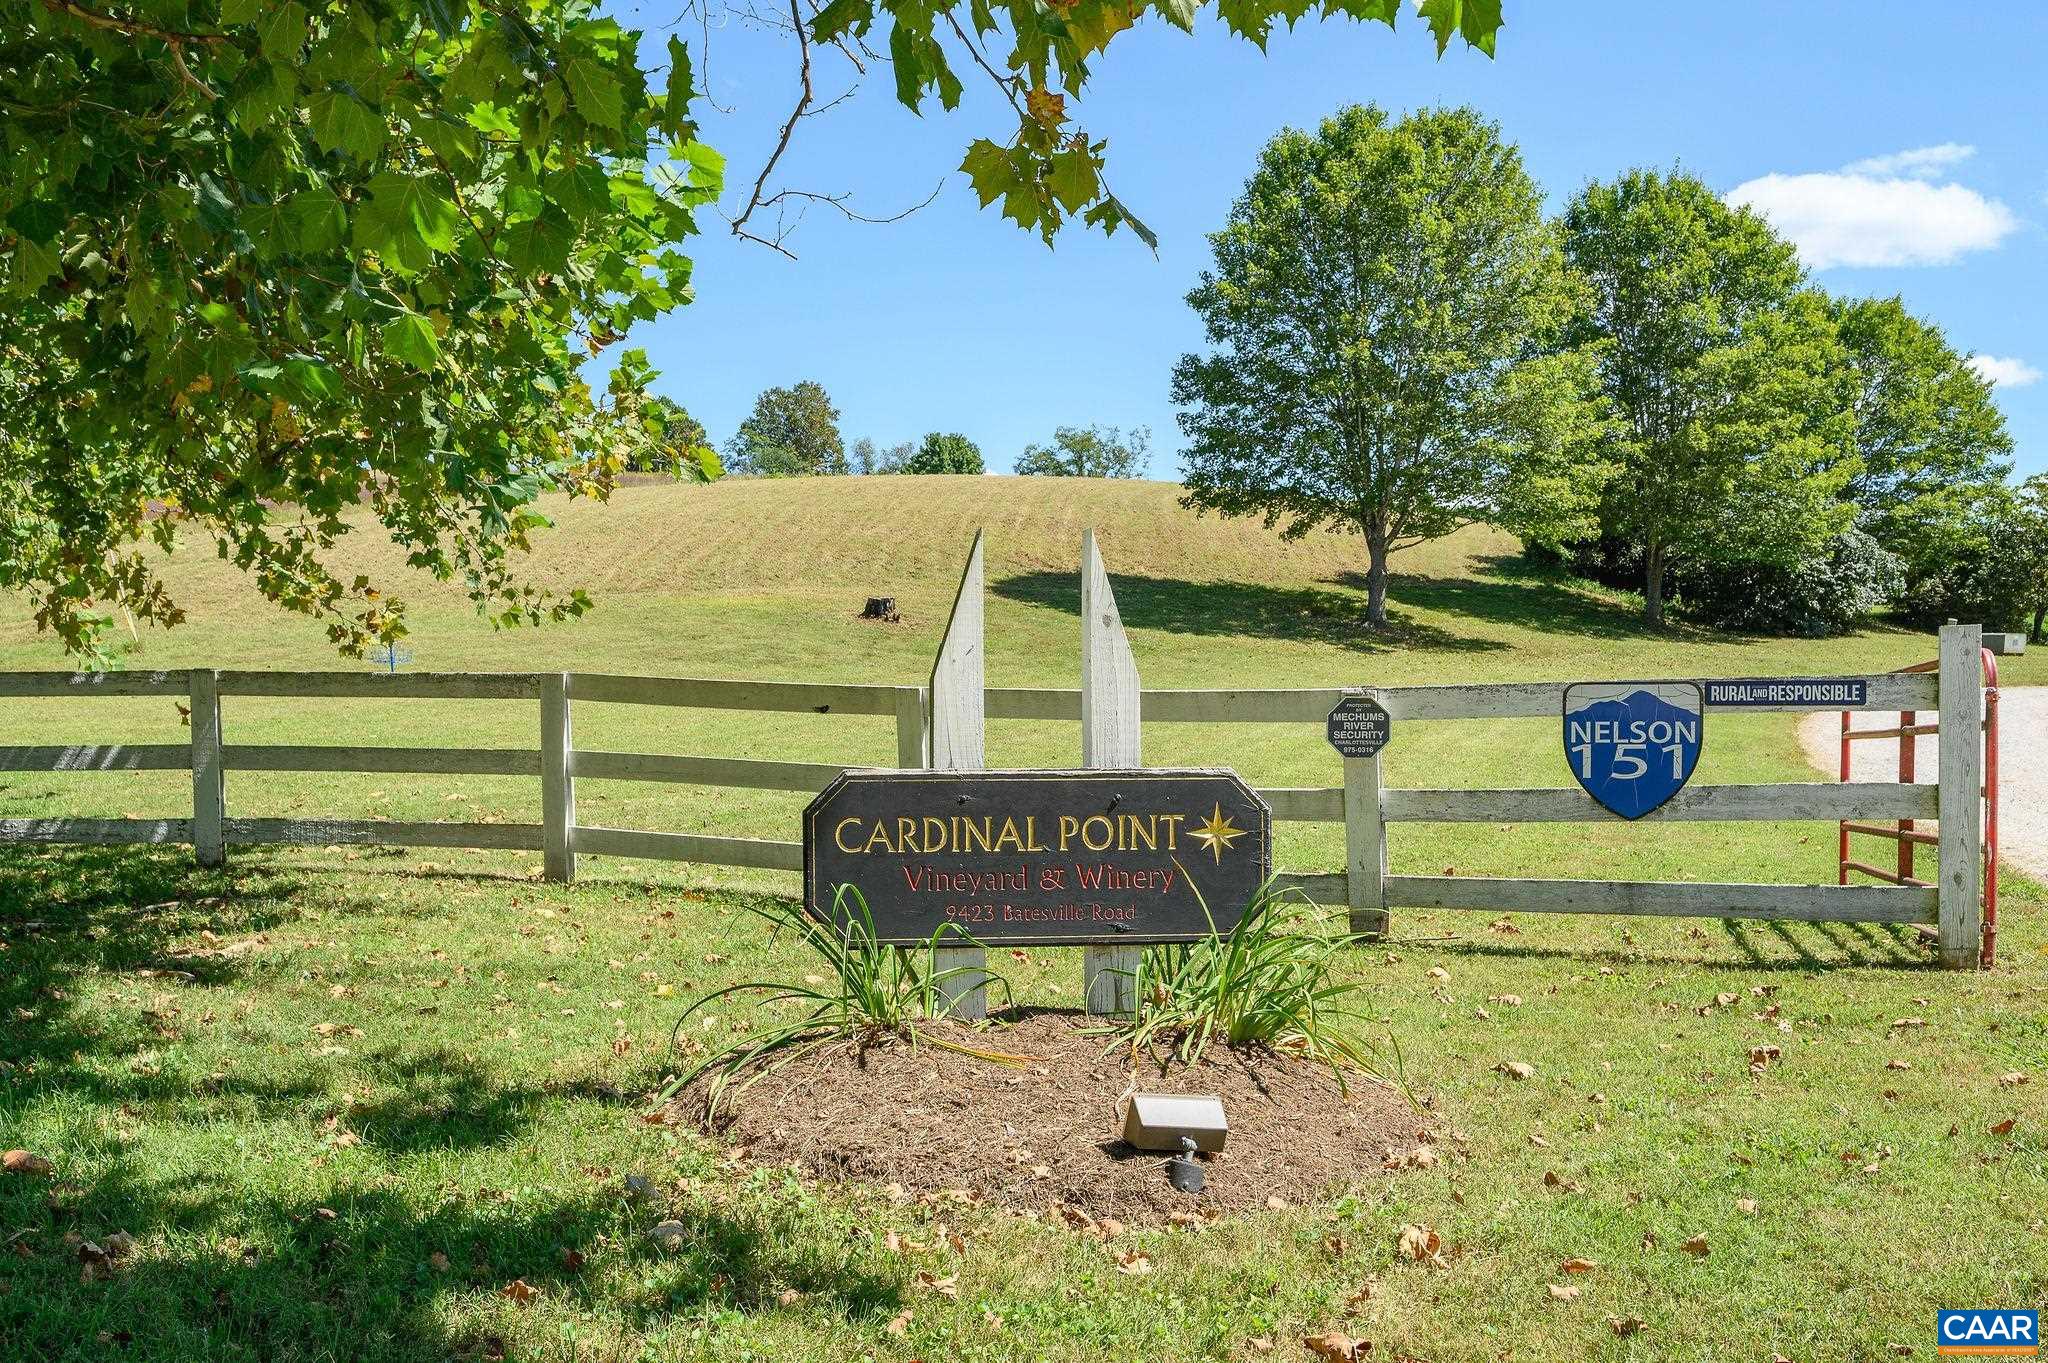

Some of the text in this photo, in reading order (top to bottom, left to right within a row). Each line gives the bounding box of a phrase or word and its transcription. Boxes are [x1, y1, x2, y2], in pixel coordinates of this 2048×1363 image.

[1711, 684, 1860, 701] RURAL AND RESPONSIBLE
[1333, 712, 1385, 721] MECHUMS
[1343, 721, 1374, 730] RIVER
[1333, 730, 1384, 739] SECURITY
[1570, 720, 1696, 744] NELSON
[1571, 743, 1683, 780] 151
[835, 814, 1186, 853] CARDINAL POINT
[903, 863, 1175, 896] Vineyard & Winery
[945, 902, 1136, 923] 9423 Batesville Road
